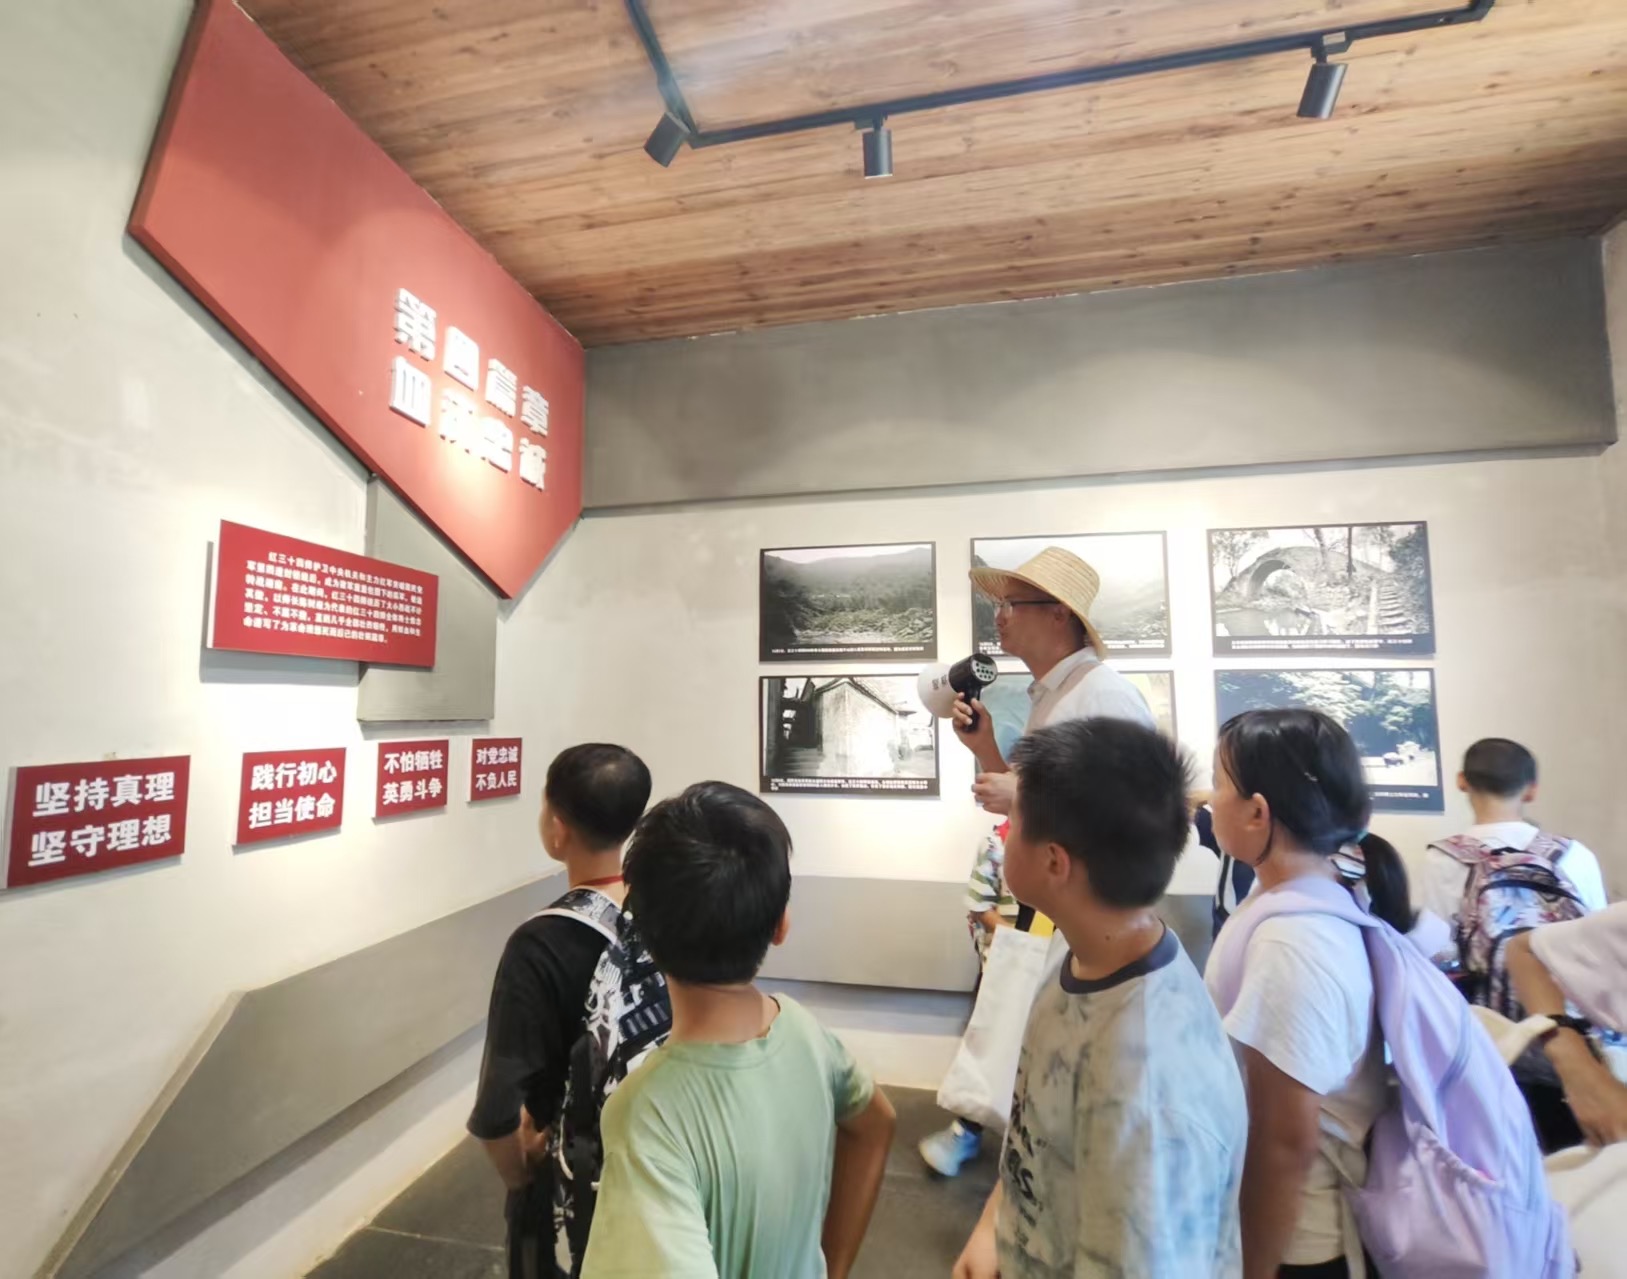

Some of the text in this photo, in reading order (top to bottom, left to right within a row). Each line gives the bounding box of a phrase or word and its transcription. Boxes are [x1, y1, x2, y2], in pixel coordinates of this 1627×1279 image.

[394, 287, 548, 436] 第四篇章
[383, 749, 443, 774] 不怕牺牲
[476, 746, 519, 765] 对党忠诚
[251, 760, 337, 791] 践行初心
[475, 770, 517, 791] 不负人民
[32, 772, 175, 817] 坚持真理
[382, 778, 442, 805] 英勇斗争
[248, 793, 336, 829] 担当使命
[28, 814, 172, 867] 坚守理想
